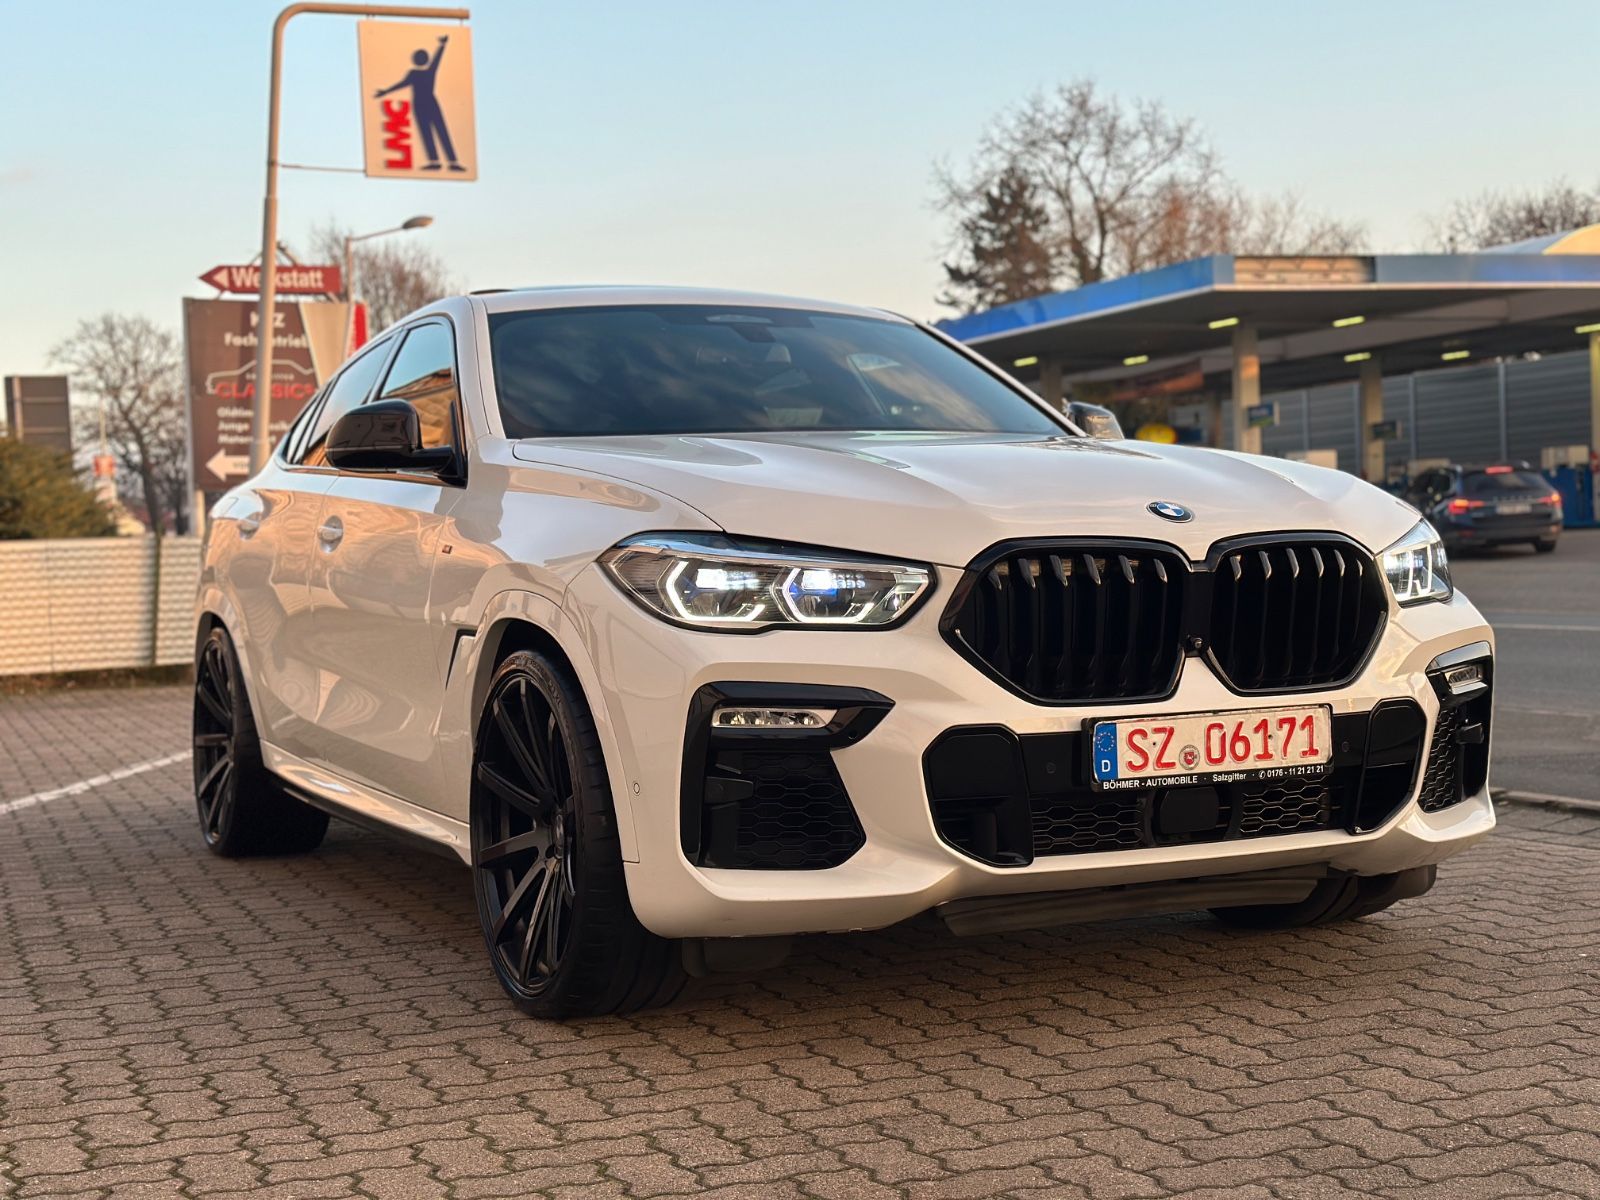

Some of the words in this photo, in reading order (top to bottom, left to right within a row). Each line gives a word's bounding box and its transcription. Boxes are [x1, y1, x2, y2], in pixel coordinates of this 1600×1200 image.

[231, 266, 324, 289] Westatt
[249, 311, 286, 328] KZ
[224, 332, 310, 348] Fachtrie
[1126, 726, 1176, 772] SZ
[1205, 715, 1319, 765] 06171
[1101, 759, 1111, 772] D
[1103, 779, 1140, 790] BÖHMER
[1146, 776, 1198, 787] AUTOMOBILE
[1212, 773, 1247, 783] Salzgitter
[1267, 768, 1284, 778] 0176
[1297, 767, 1305, 775] 21
[1306, 766, 1314, 774] 21
[1316, 764, 1324, 773] 21
